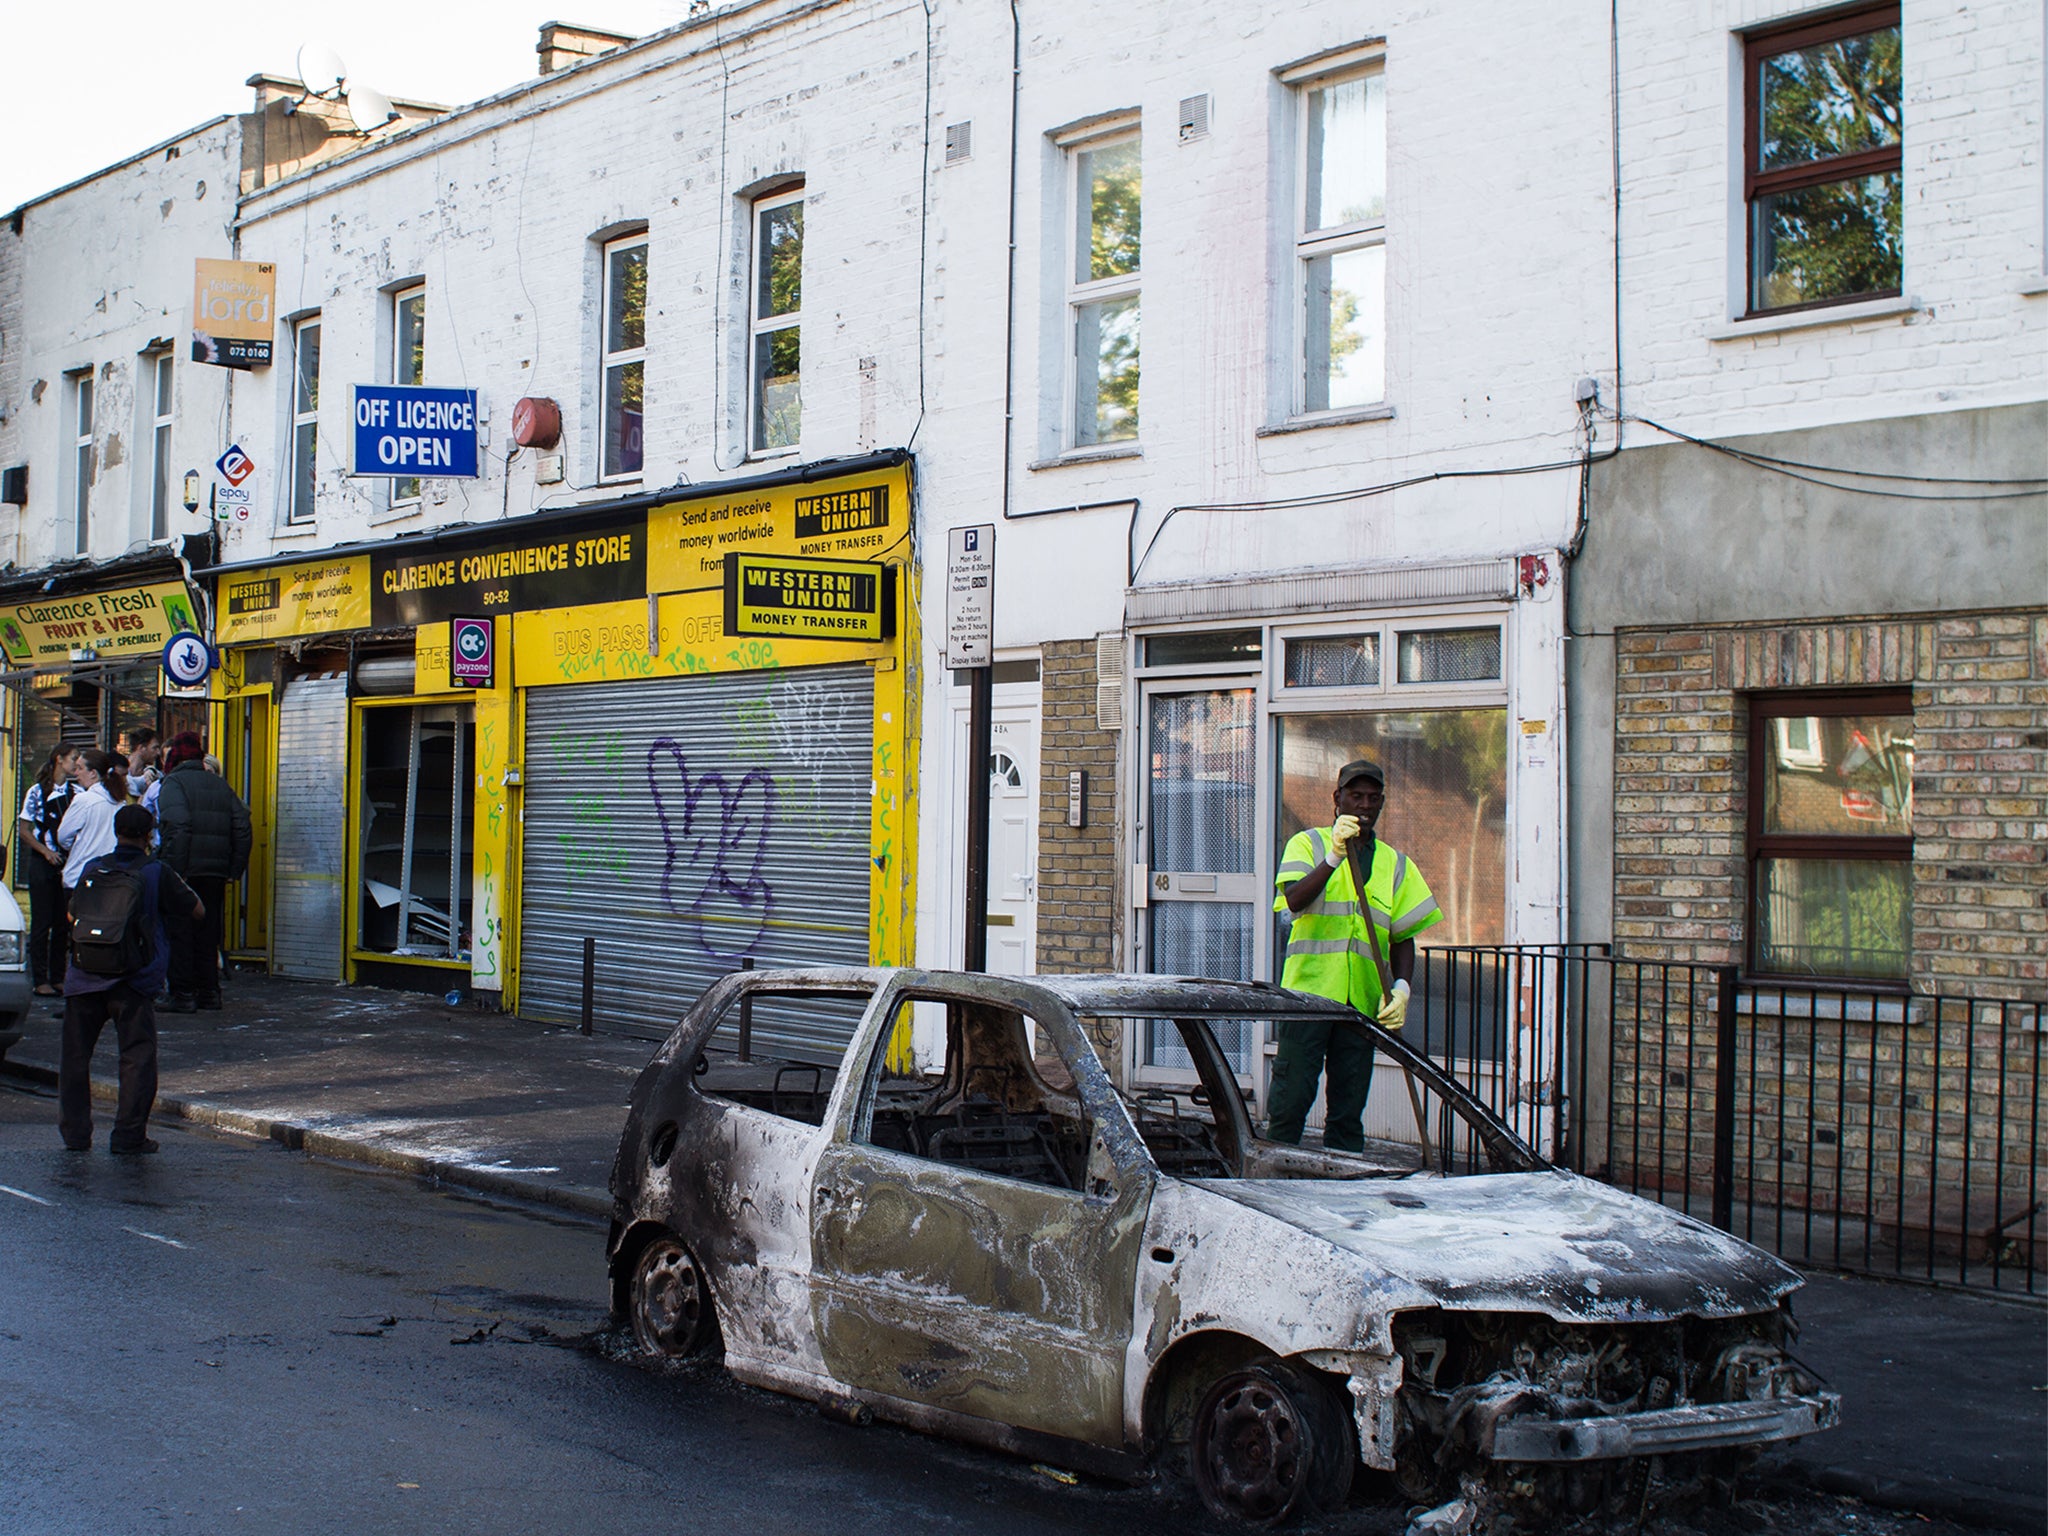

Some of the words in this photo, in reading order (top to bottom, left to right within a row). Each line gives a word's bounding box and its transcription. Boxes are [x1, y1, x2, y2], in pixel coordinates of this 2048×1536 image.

[258, 264, 272, 273] let
[201, 288, 269, 322] lord
[229, 346, 246, 357] 072
[247, 348, 269, 358] 0160
[357, 398, 390, 427] OFF
[397, 400, 473, 430] LICENCE
[378, 435, 451, 466] OPEN
[219, 487, 250, 502] epay
[797, 491, 871, 517] WESTERN
[681, 508, 707, 526] Send
[710, 504, 729, 521] and
[732, 498, 772, 518] receive
[821, 509, 871, 532] UNION
[679, 534, 713, 549] money
[718, 522, 774, 544] worldwide
[800, 541, 832, 555] MONEY
[836, 534, 884, 551] TRANSFER
[967, 532, 976, 550] P
[293, 570, 310, 583] Send
[311, 567, 324, 581] and
[325, 563, 351, 578] receive
[383, 560, 456, 595] CLARENCE
[460, 543, 569, 584] CONVENIENCE
[574, 534, 632, 568] STORE
[747, 569, 851, 592] WESTERN
[230, 582, 271, 600] WESTERN
[291, 592, 314, 603] money
[316, 583, 353, 599] worldwide
[483, 590, 510, 606] 50-52
[782, 589, 851, 609] UNION
[16, 601, 97, 625] Clarence
[97, 589, 157, 615] Fresh
[243, 596, 271, 611] UNION
[304, 609, 322, 621] from
[322, 607, 339, 619] here
[751, 612, 797, 626] MONEY
[802, 615, 868, 630] TRANSFER
[43, 621, 88, 640] FRUIT
[92, 619, 106, 635] &
[106, 614, 144, 632] VEG
[554, 628, 592, 656] BUS
[683, 615, 723, 645] OFF
[38, 643, 68, 654] COOKING
[117, 632, 162, 647] SPECIALIST
[950, 634, 959, 642] Pay
[457, 662, 489, 673] payzone
[951, 656, 970, 665] Display
[1155, 874, 1170, 891] 48
